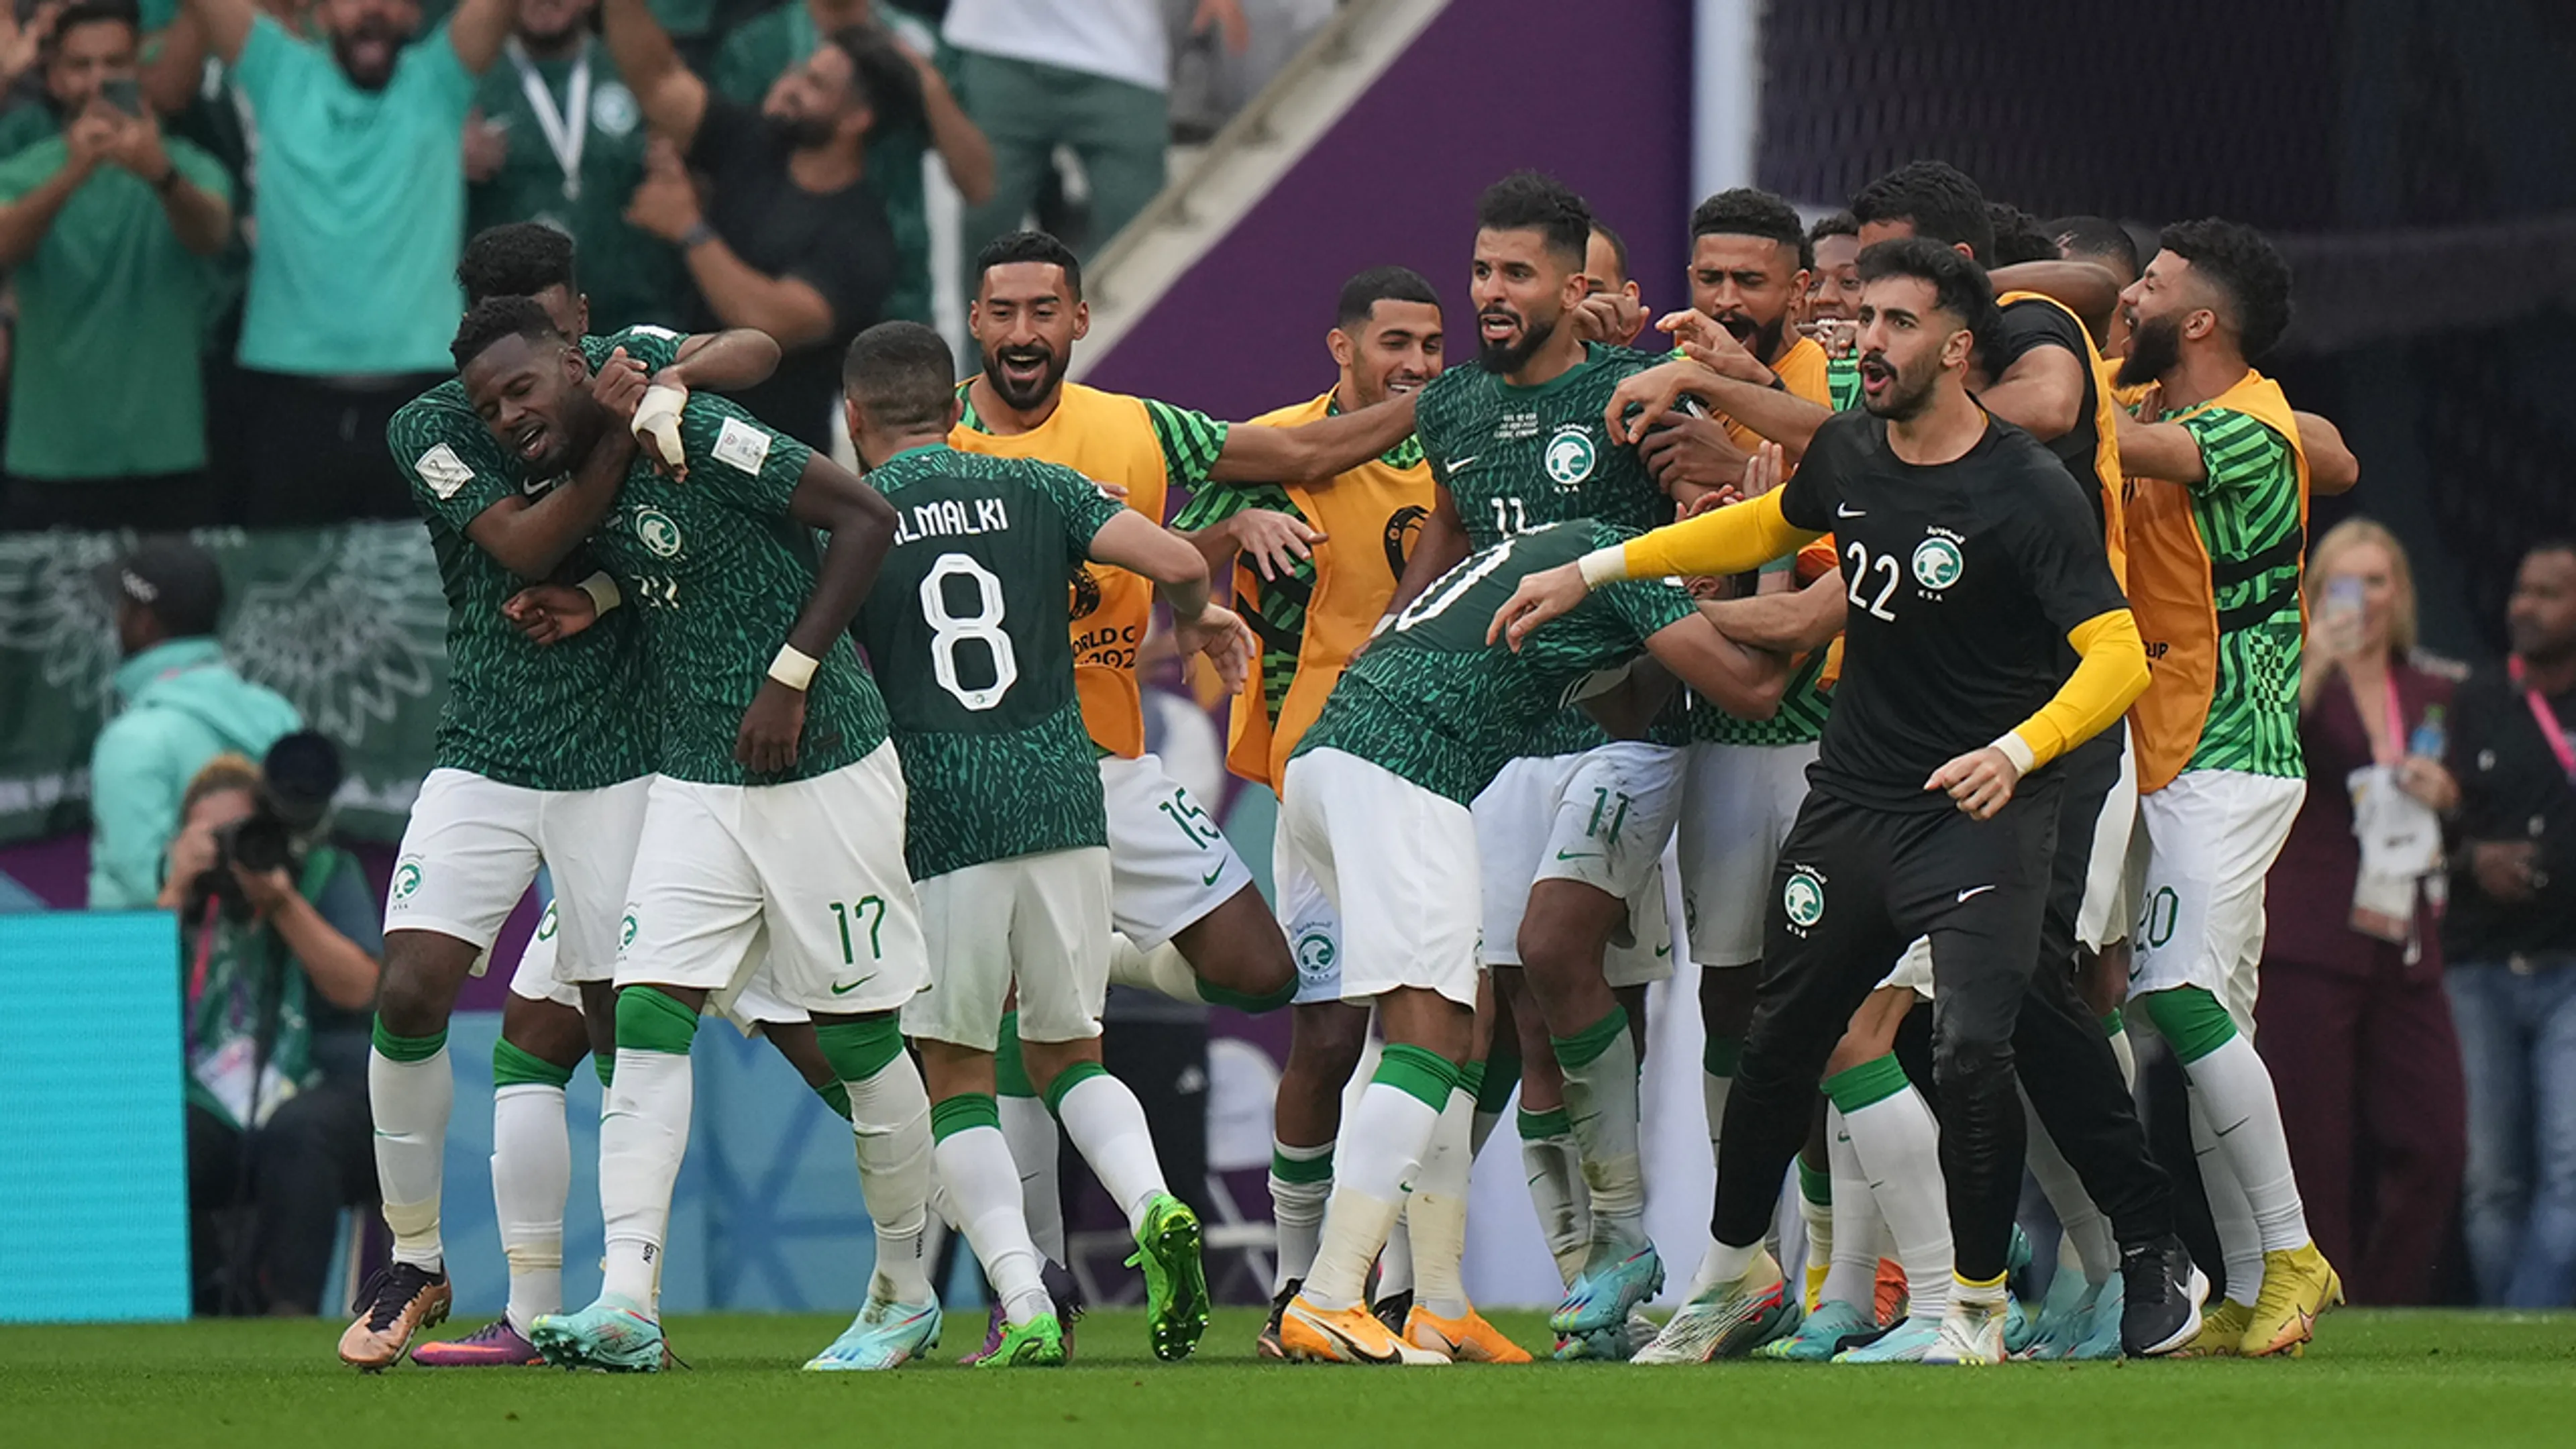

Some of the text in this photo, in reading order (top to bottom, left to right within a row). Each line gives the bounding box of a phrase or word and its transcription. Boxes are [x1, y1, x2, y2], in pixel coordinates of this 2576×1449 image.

[894, 498, 1009, 545] LMALKI
[1491, 497, 1526, 539] 11
[1847, 541, 1900, 622] 22
[920, 553, 1018, 711] 8
[1072, 628, 1118, 657] ORLD
[2143, 640, 2169, 660] UP
[1159, 787, 1220, 850] 15
[1586, 787, 1629, 845] 11
[828, 894, 885, 965] 17
